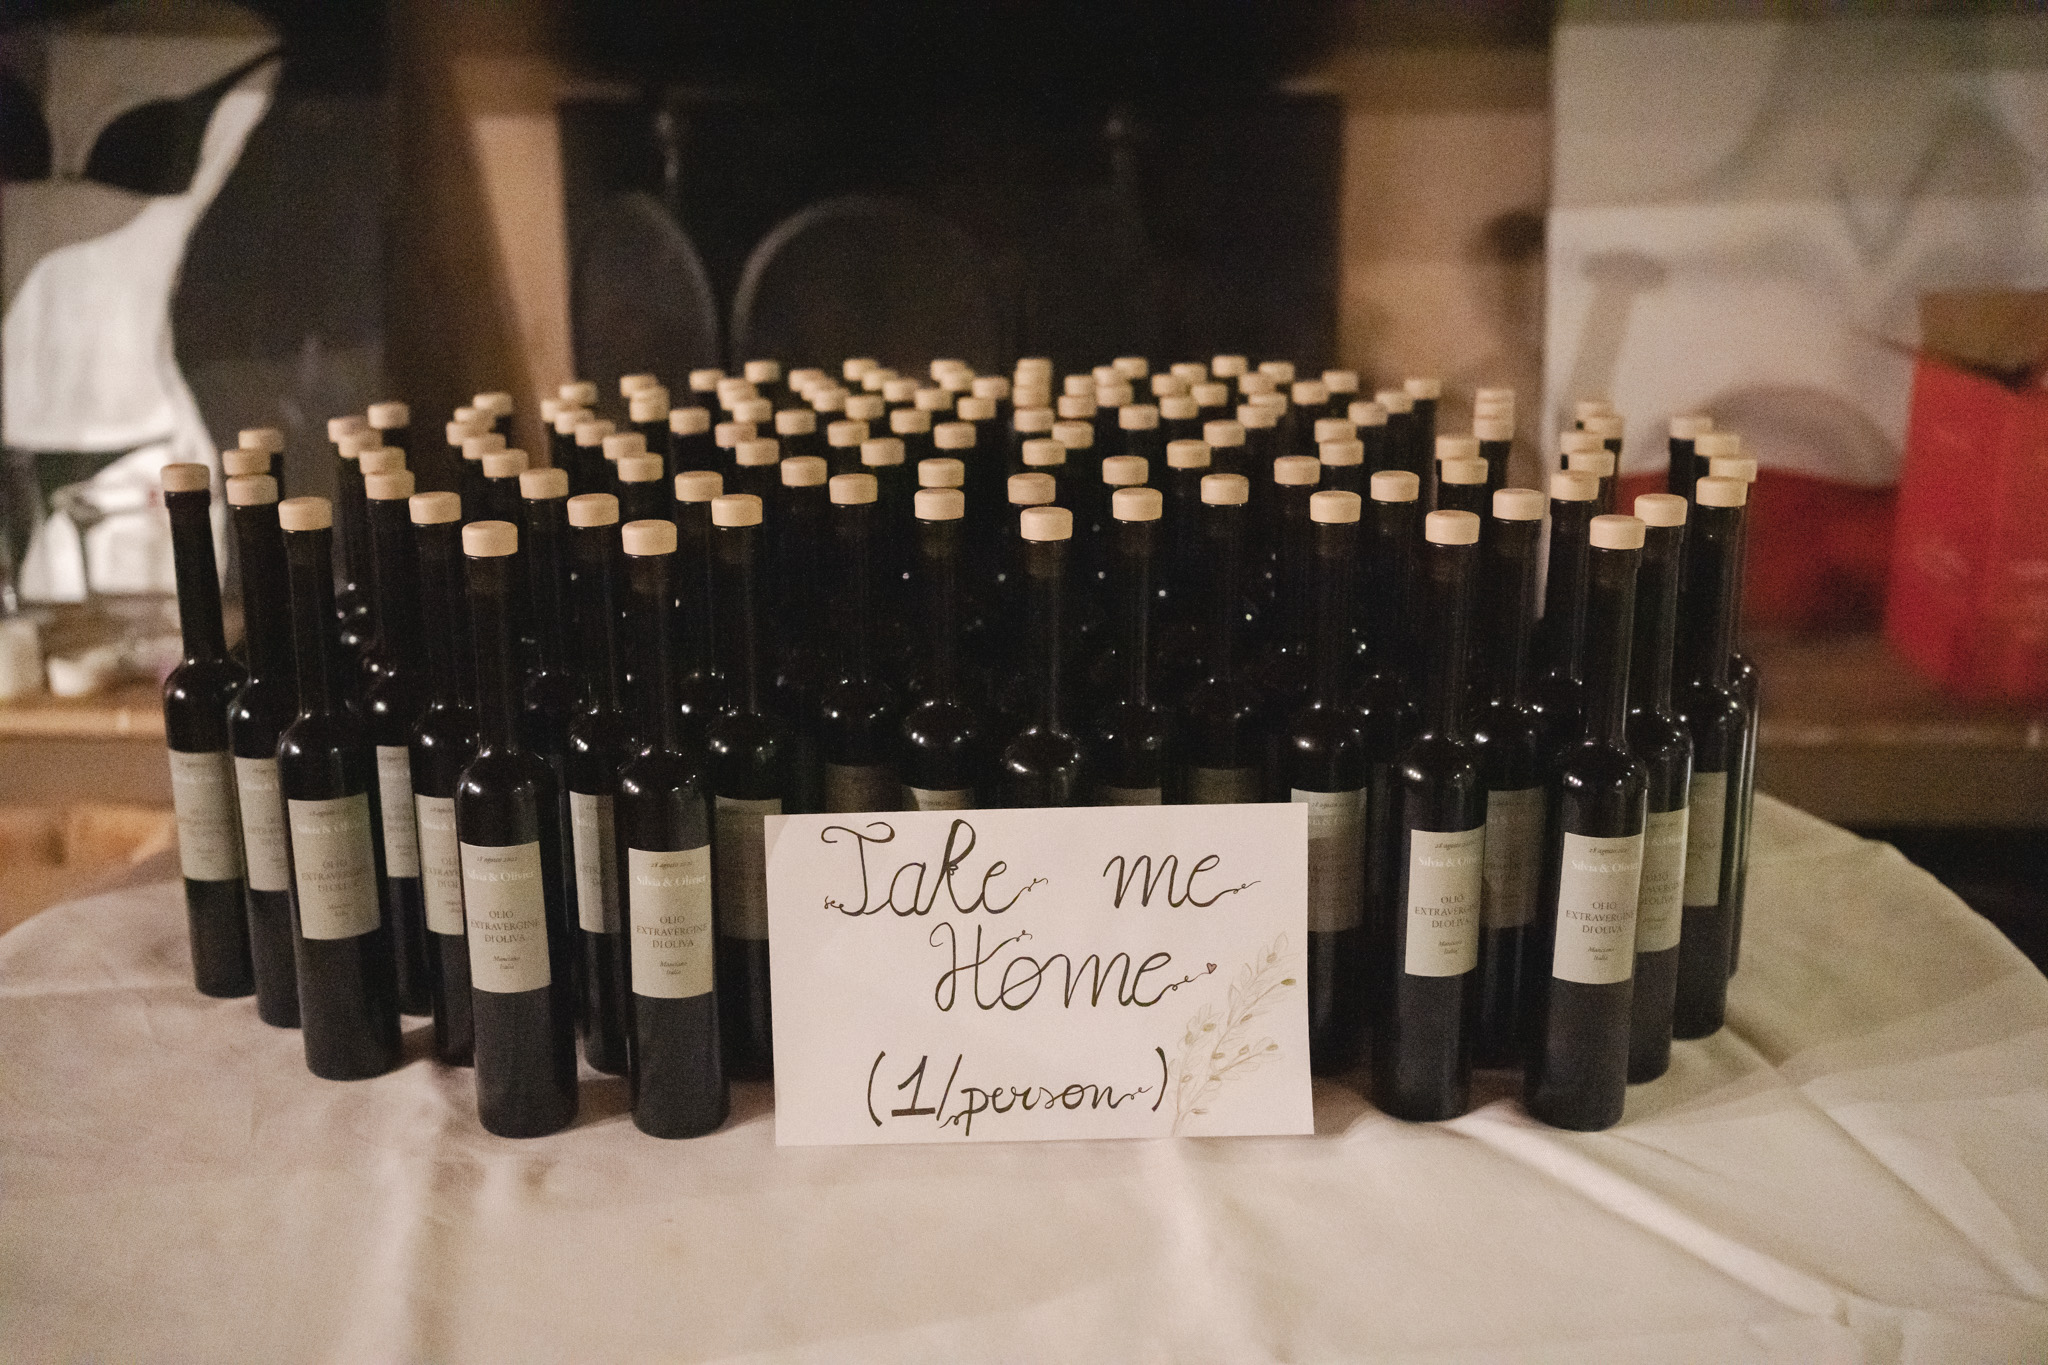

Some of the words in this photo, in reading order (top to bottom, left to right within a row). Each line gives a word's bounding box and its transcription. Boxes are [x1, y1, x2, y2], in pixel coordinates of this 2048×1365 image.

[821, 819, 1047, 916] Take
[1103, 854, 1261, 909] me
[1440, 894, 1464, 904] OLIO
[1592, 902, 1617, 910] OLIO
[489, 910, 514, 919] OLIO
[660, 916, 685, 924] OLIO
[637, 924, 706, 936] EXTRAVERGINE
[930, 922, 1200, 1012] Home
[867, 1047, 1170, 1136] (1/person)
